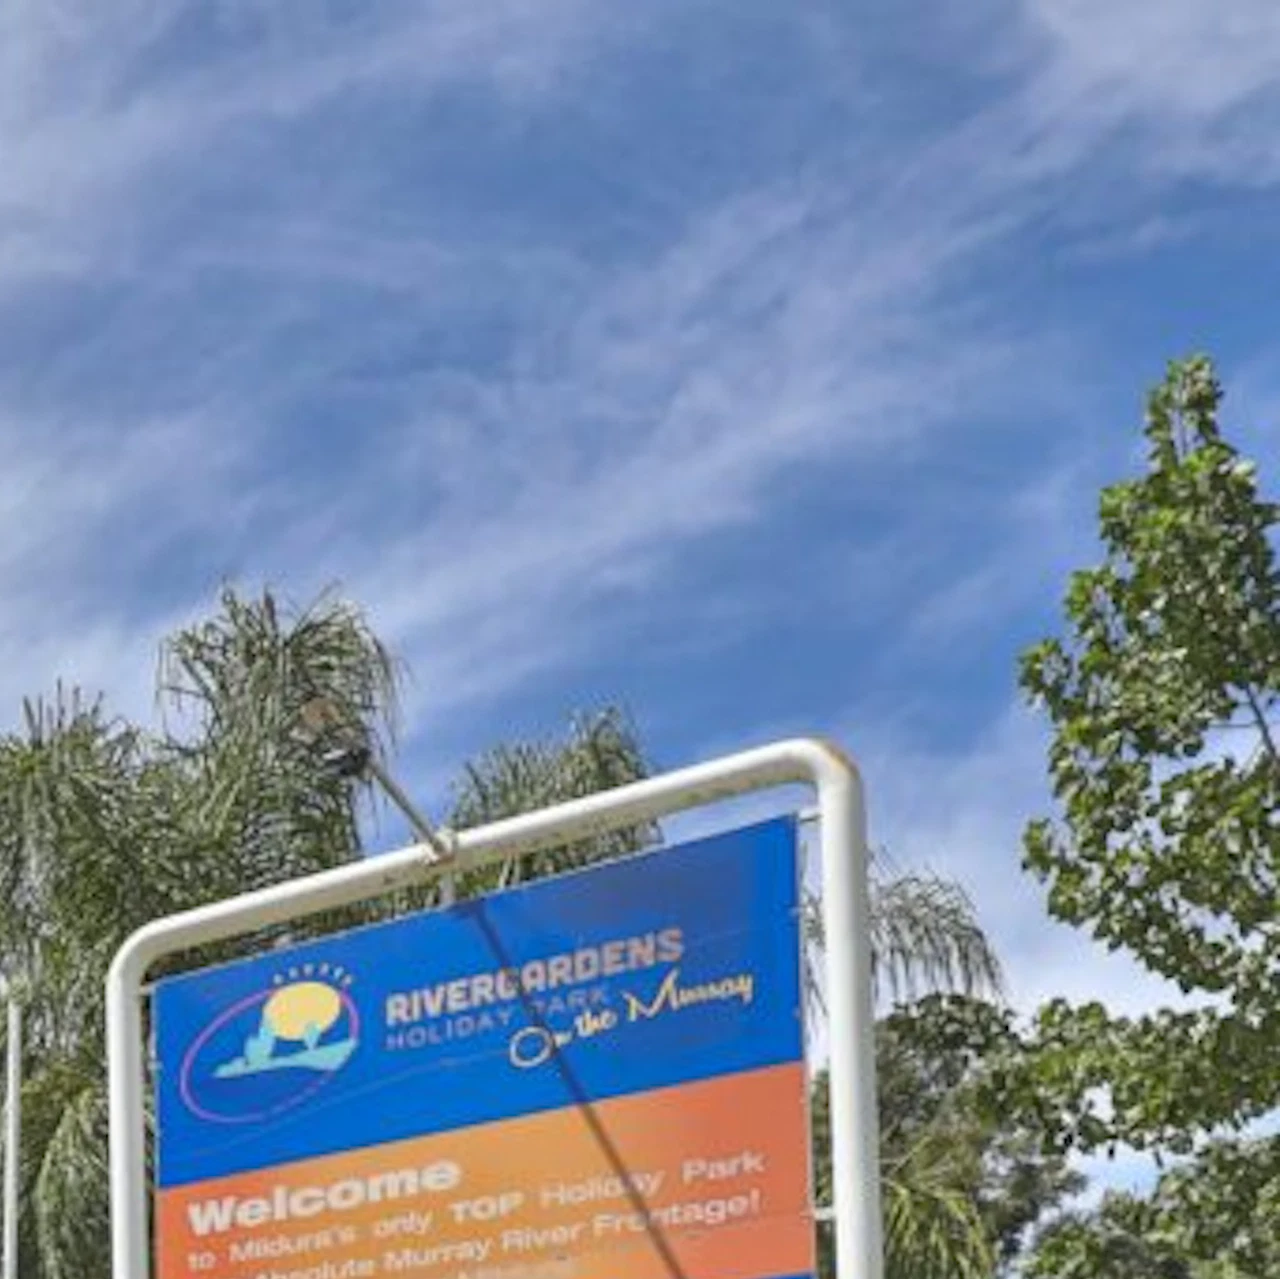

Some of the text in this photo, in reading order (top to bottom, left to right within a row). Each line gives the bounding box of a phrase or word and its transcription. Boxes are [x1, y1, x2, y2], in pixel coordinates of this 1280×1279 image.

[385, 928, 685, 1027] RIVERGARDENS
[385, 1008, 513, 1051] HOLIDAY
[508, 1026, 573, 1068] On
[573, 1009, 619, 1038] the
[188, 1160, 462, 1237] Welcome
[188, 1249, 218, 1271] to
[374, 1208, 436, 1239] only
[451, 1190, 525, 1224] TOP
[541, 1169, 667, 1207] Holiday
[681, 1149, 766, 1184] Park
[382, 1236, 494, 1272] Murray
[501, 1221, 586, 1253] River
[592, 1187, 762, 1237] Frontage!
